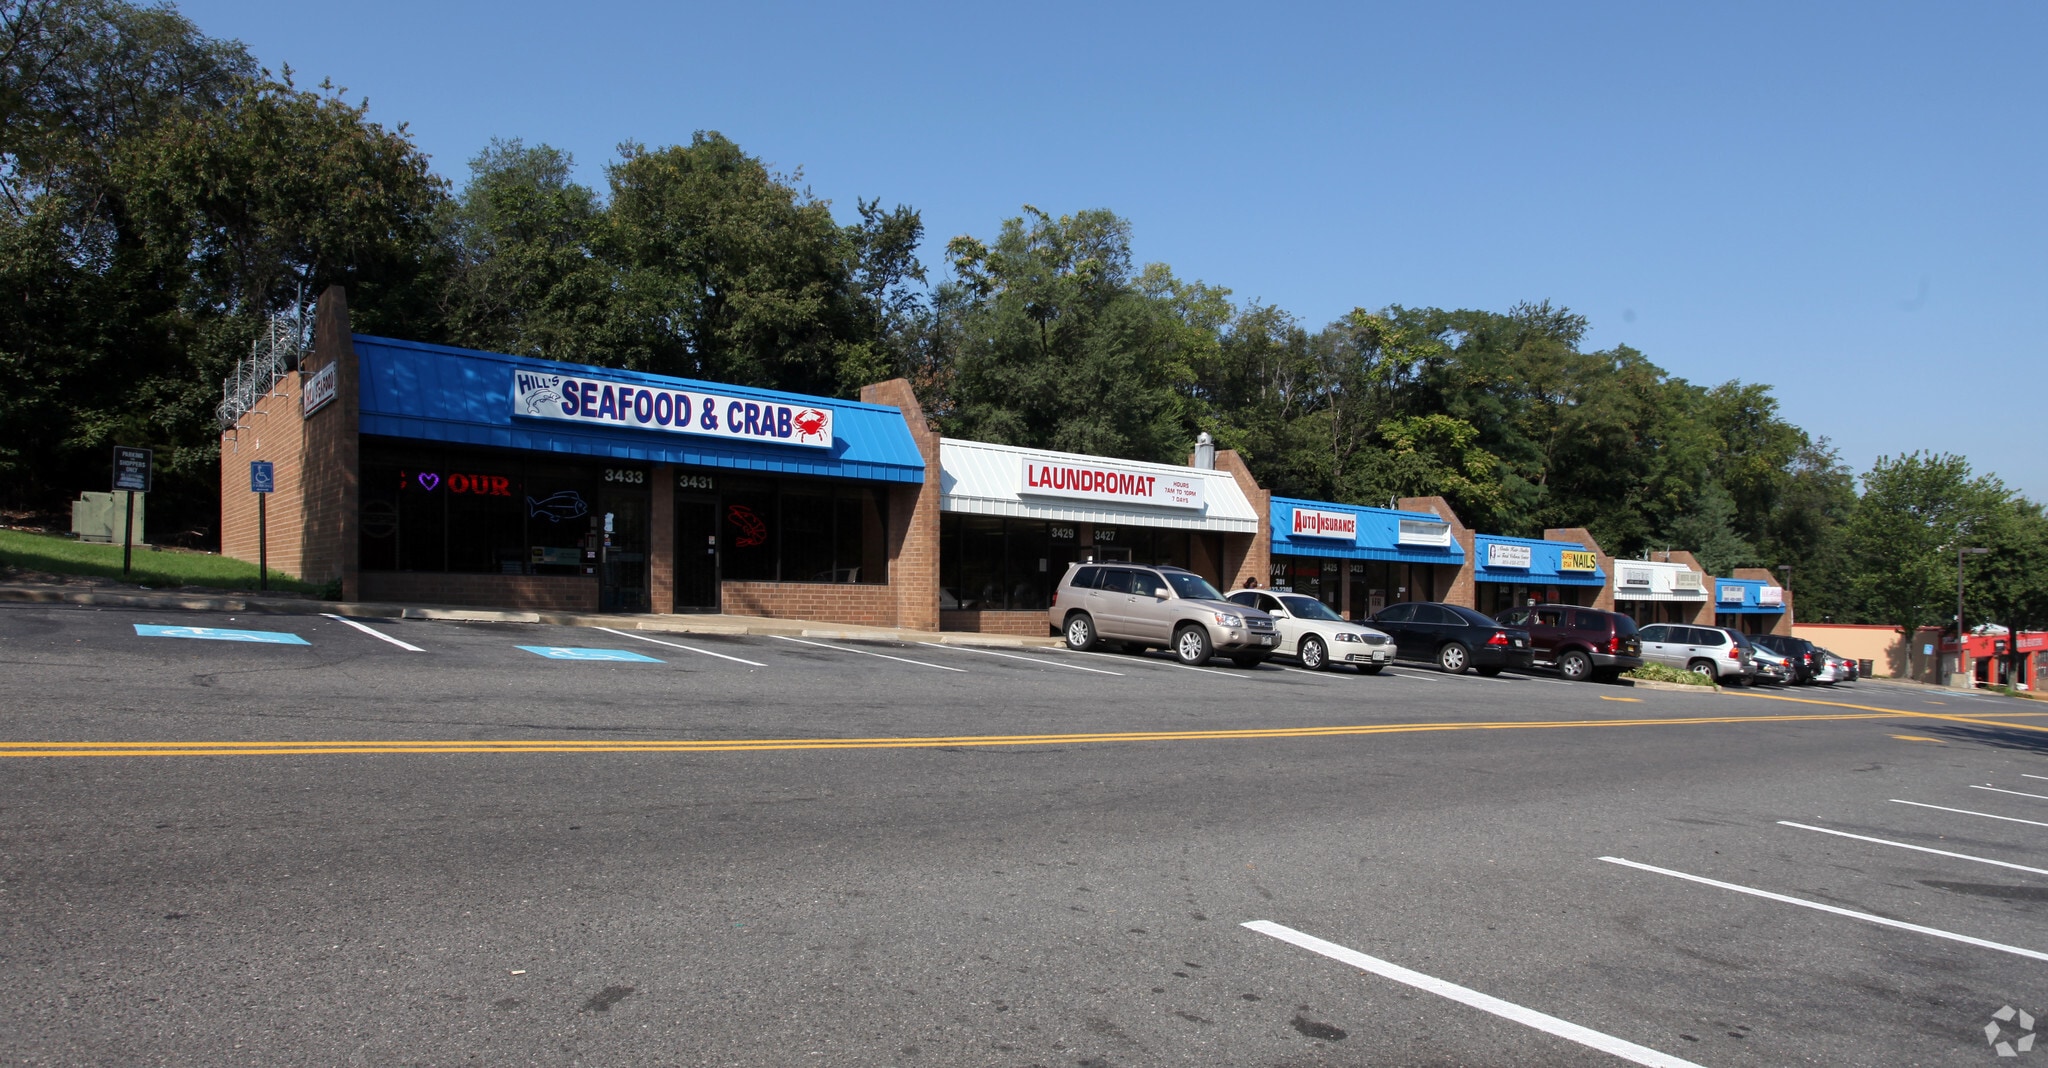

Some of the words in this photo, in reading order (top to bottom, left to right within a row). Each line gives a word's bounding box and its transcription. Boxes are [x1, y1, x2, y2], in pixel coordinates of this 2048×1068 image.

[517, 374, 560, 395] HILL'S
[561, 379, 692, 427] SEAFOOD
[700, 397, 719, 431] &
[727, 400, 793, 438] CRAB
[604, 469, 644, 484] 3433
[680, 475, 713, 489] 3431
[1028, 464, 1155, 497] LAUNDROMAT
[448, 473, 511, 497] OUR
[1052, 527, 1074, 539] 3429
[1095, 530, 1115, 541] 3427
[1573, 553, 1596, 569] NAILS
